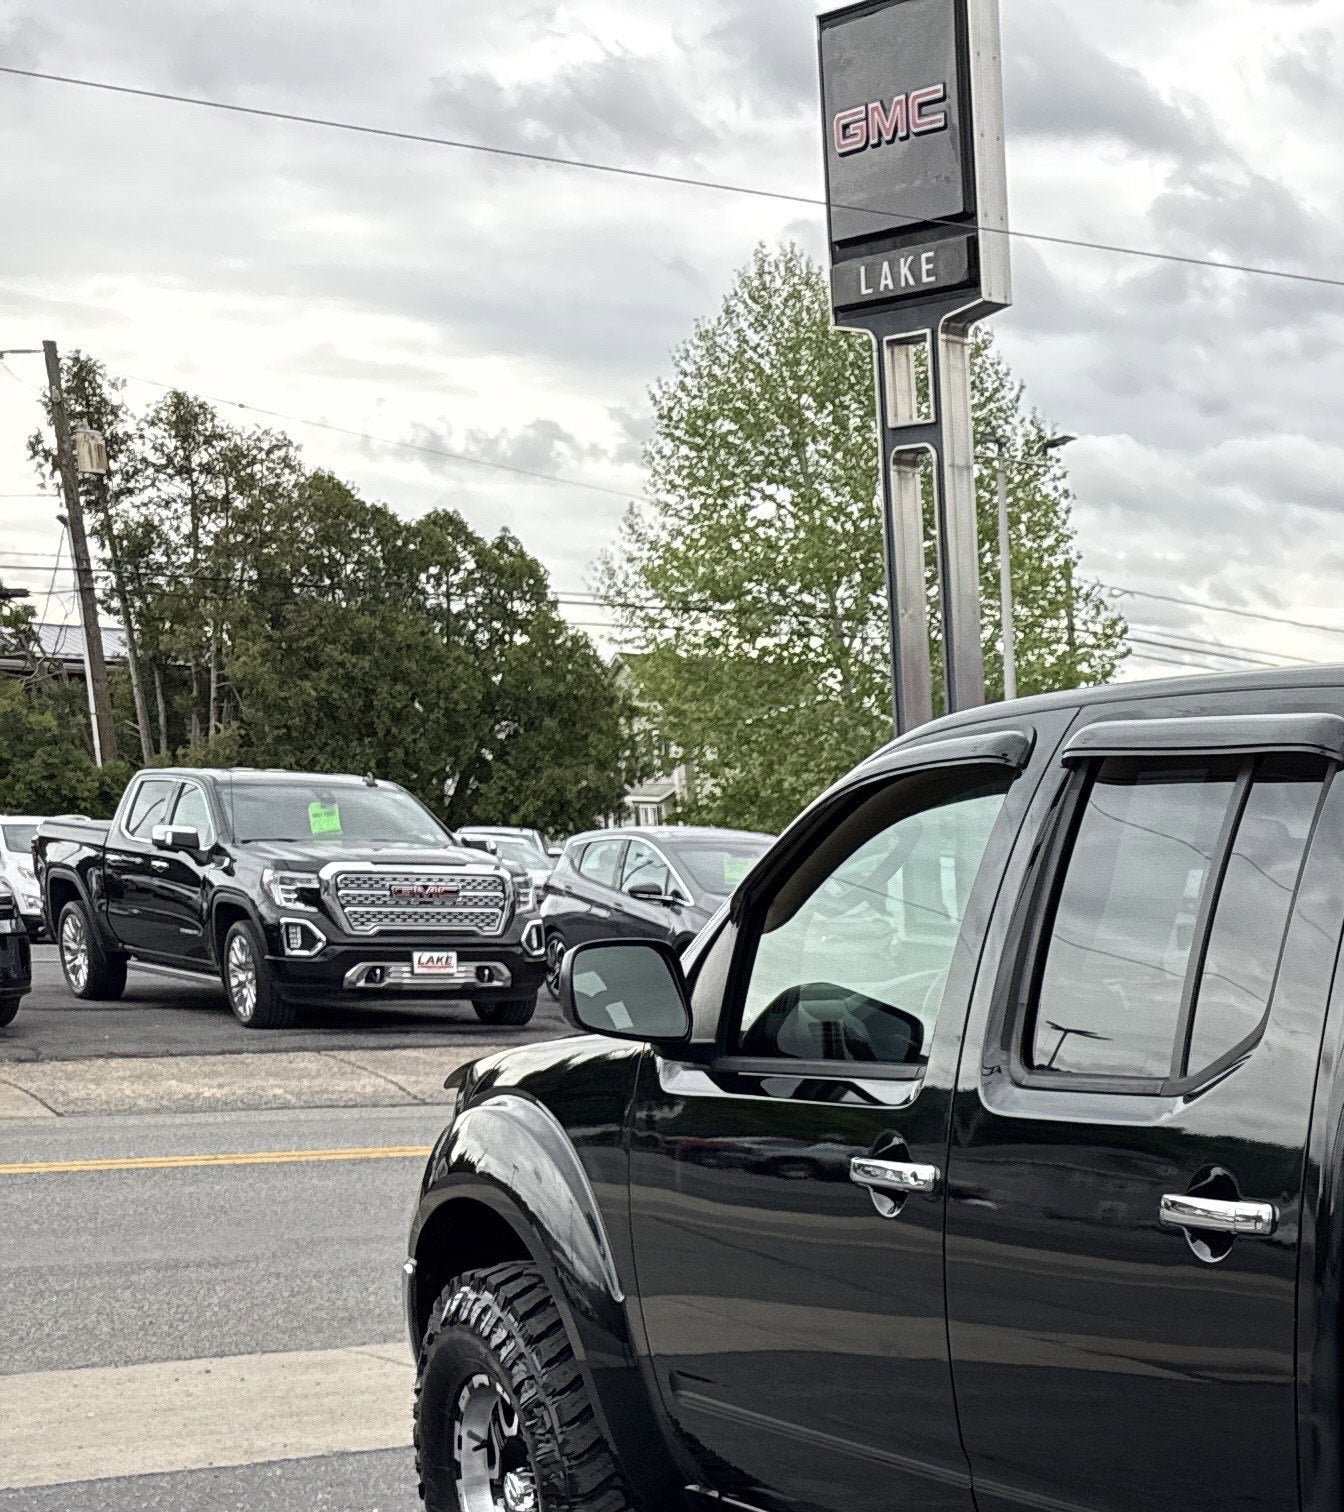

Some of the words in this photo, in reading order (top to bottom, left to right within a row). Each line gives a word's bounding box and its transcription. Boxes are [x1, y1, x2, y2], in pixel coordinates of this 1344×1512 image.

[833, 83, 947, 157] GMC
[860, 251, 936, 295] LAKE
[417, 955, 454, 966] LAKE
